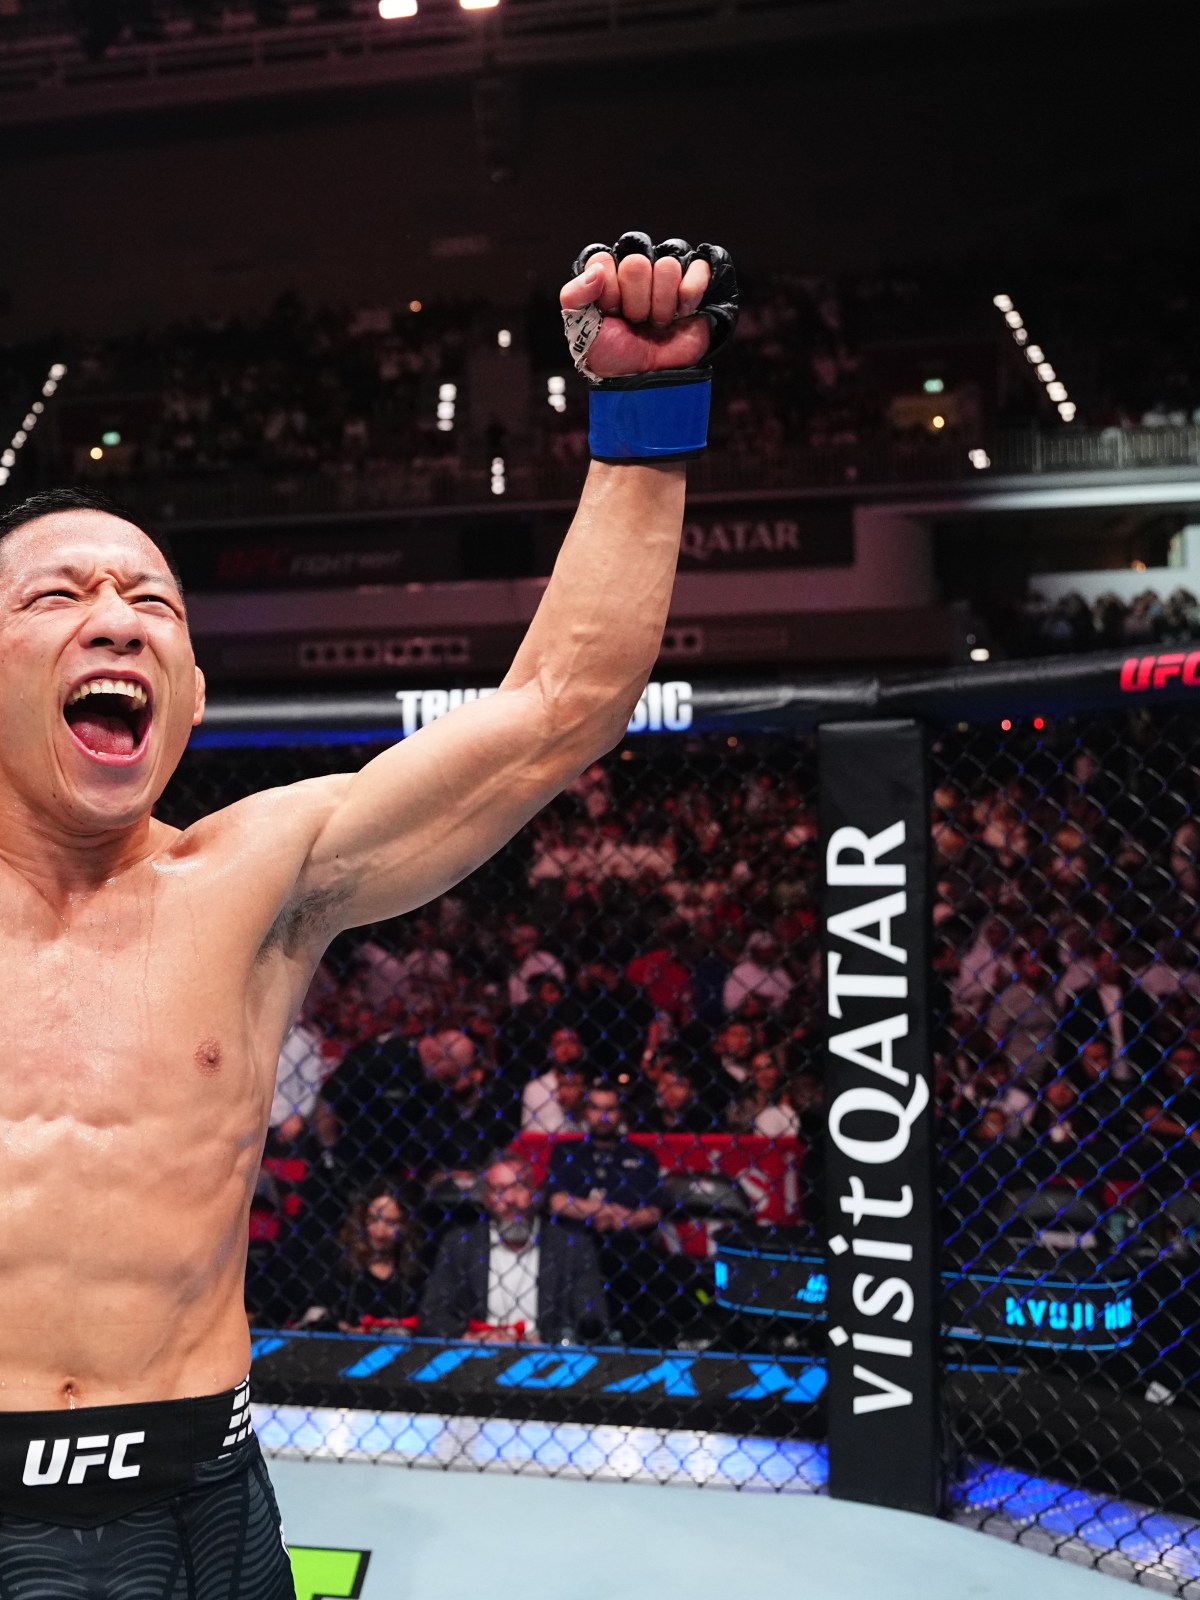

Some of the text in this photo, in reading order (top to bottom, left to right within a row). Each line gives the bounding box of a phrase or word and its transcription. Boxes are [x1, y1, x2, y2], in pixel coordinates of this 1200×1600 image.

[572, 324, 592, 354] UFC
[681, 519, 800, 561] QATAR
[395, 687, 498, 737] TR
[22, 1430, 146, 1486] UFC
